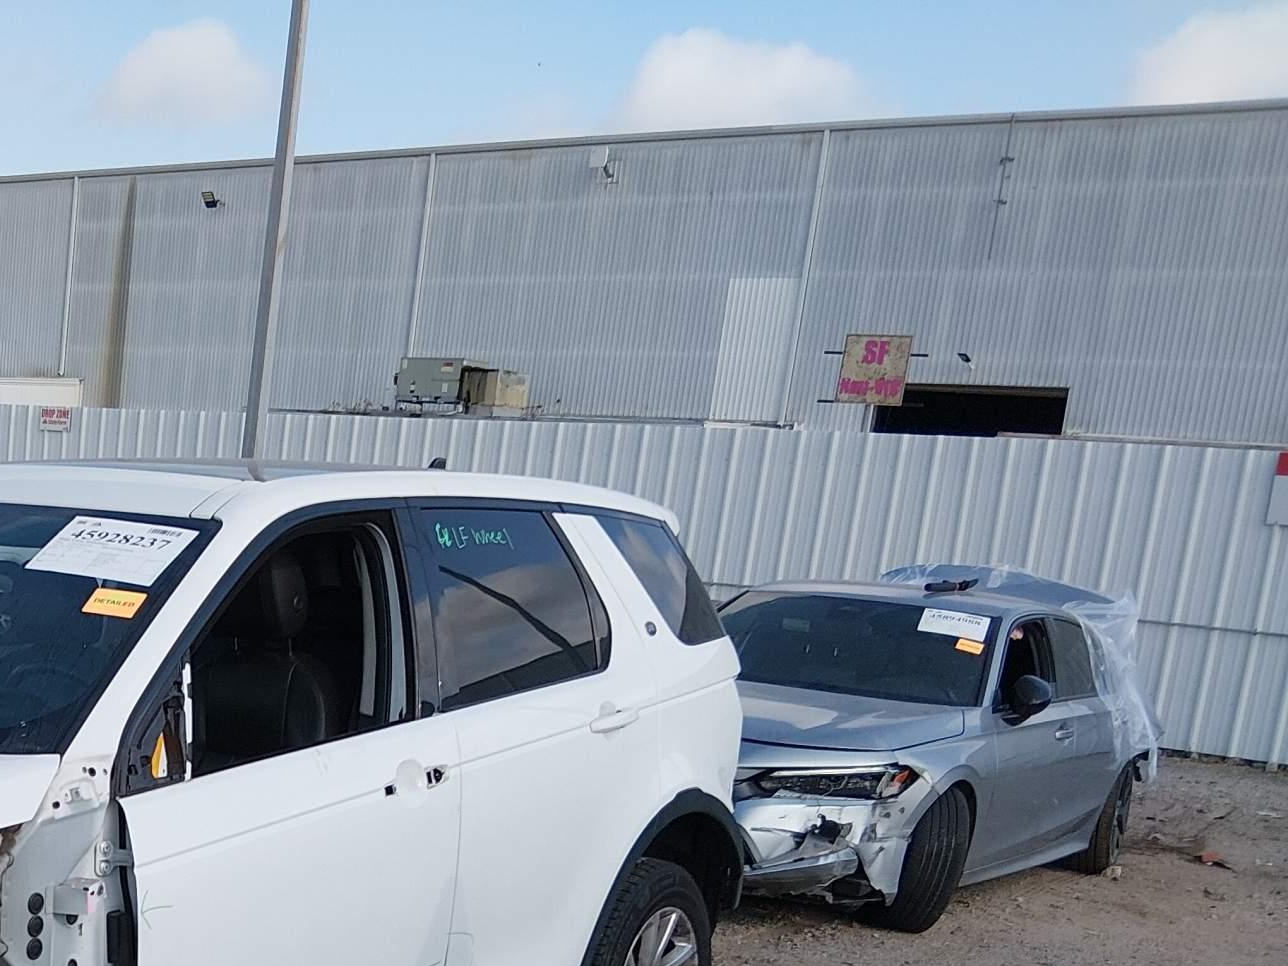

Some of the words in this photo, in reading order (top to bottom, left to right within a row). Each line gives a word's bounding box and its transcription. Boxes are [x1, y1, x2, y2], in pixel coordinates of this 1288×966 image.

[41, 408, 55, 418] DROP
[56, 409, 70, 419] ZONE
[70, 527, 172, 551] 45928237
[93, 596, 136, 608] DETAILED
